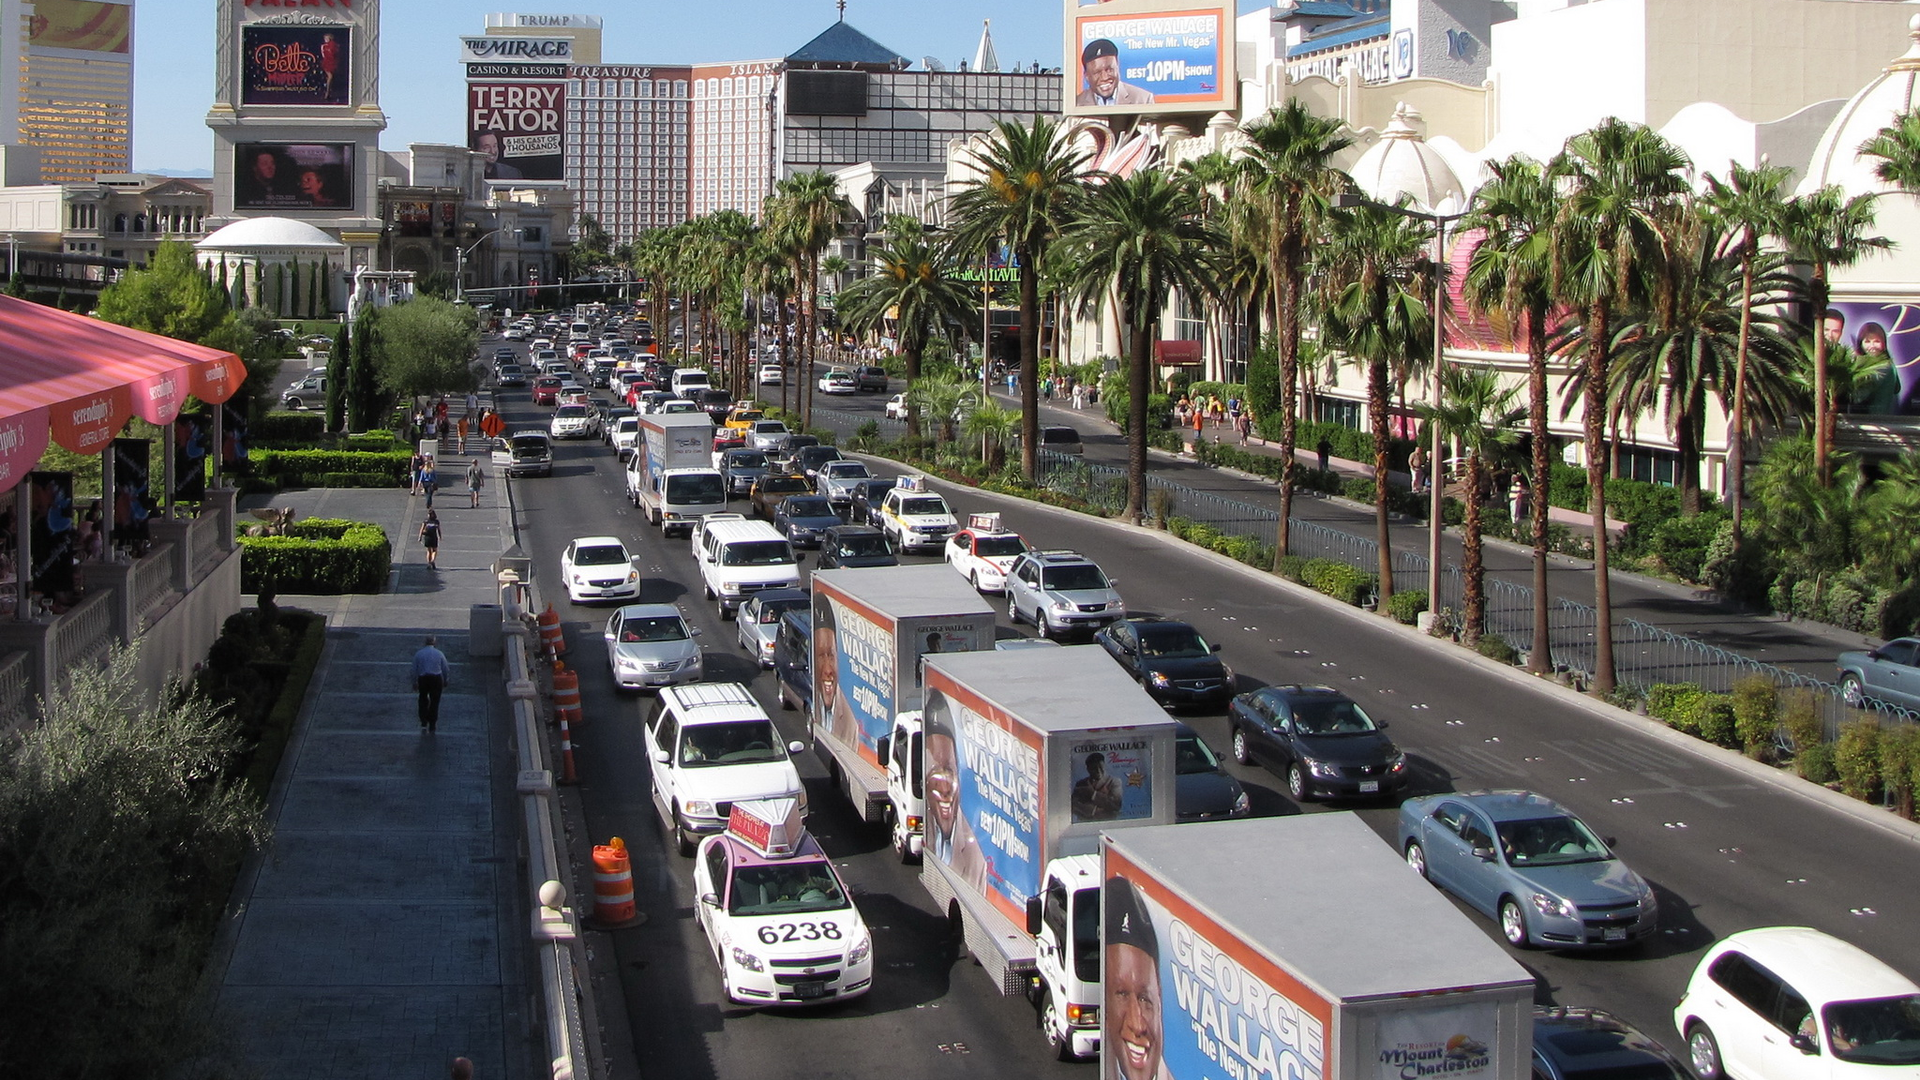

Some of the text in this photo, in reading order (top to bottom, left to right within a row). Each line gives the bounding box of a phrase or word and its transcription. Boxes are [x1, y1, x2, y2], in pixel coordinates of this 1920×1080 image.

[519, 16, 569, 26] TRUMP
[1084, 17, 1215, 39] GEORGE WALLACE
[465, 40, 569, 58] THE MIRAGE
[1144, 37, 1163, 49] New
[1165, 37, 1180, 48] Mr.
[468, 65, 565, 76] CASINO & RESORT
[569, 66, 651, 78] TREASURE
[1126, 60, 1213, 82] BEST 10PM SHOW!
[472, 86, 561, 108] TERRY
[473, 108, 559, 131] FATOR
[506, 142, 558, 151] THOUSANDS
[839, 605, 893, 656] GEORGE
[841, 630, 893, 687] WALLACE
[960, 706, 1038, 780] GEORGE
[1074, 741, 1148, 753] GEORGE WALLACE
[962, 738, 1039, 820] WALLACE
[980, 810, 992, 834] BEST
[991, 812, 1014, 858] 10PM
[757, 921, 843, 945] 6238
[1168, 919, 1324, 1072] GEORGE
[1170, 959, 1323, 1080] WALLAC
[1191, 1019, 1245, 1080] "The New
[1380, 1048, 1443, 1066] Mount
[1408, 1042, 1437, 1050] RESORT
[1400, 1056, 1490, 1080] Charleston
